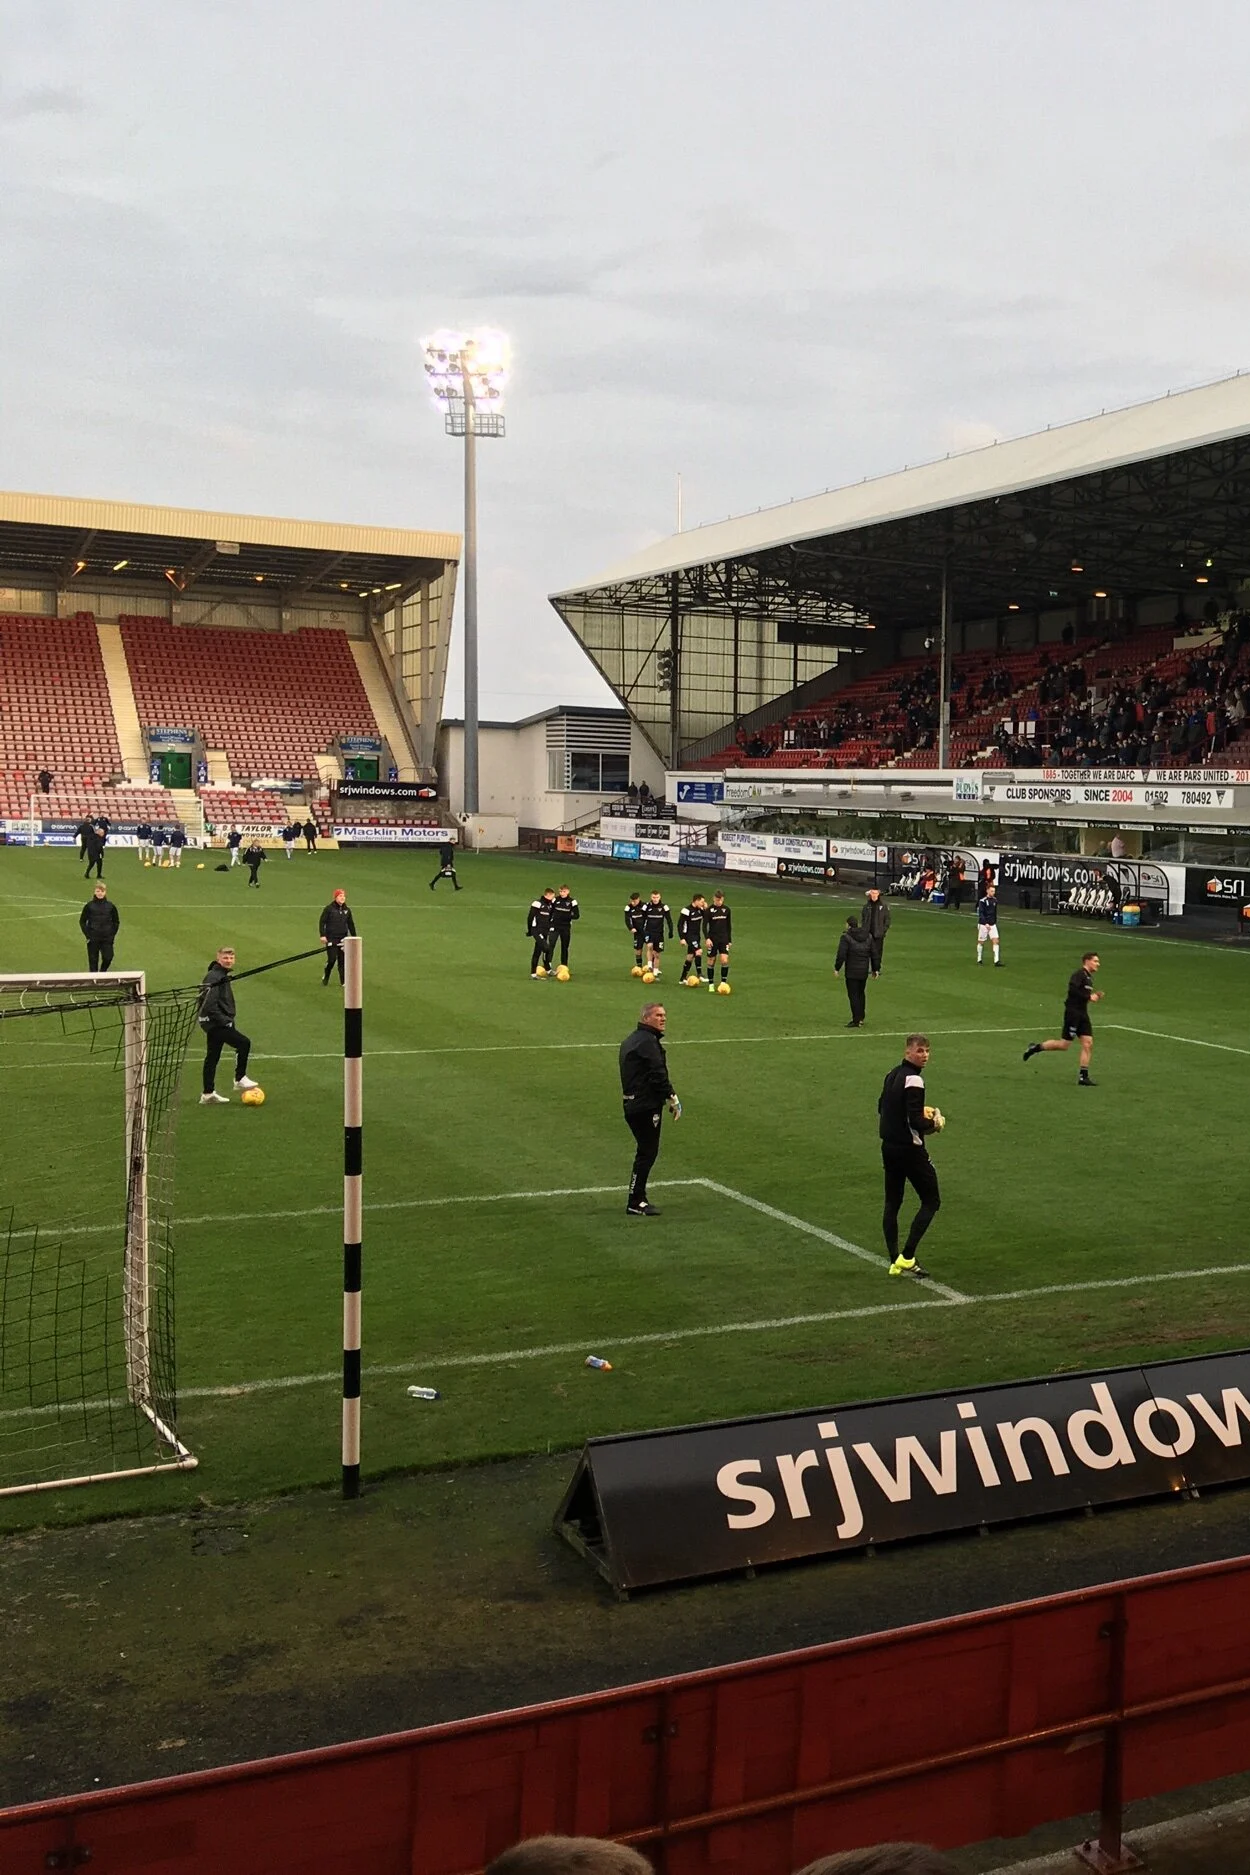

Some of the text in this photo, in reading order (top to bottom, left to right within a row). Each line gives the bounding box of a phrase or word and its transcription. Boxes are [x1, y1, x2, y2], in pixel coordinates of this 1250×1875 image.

[1061, 770, 1090, 781] TOGETHER
[1103, 771, 1116, 781] ARE
[1116, 771, 1135, 781] DAFC
[1156, 771, 1166, 781] WE
[1166, 771, 1182, 782] ARE
[1184, 771, 1202, 782] PARS
[1203, 771, 1229, 782] UNITED
[339, 785, 417, 797] srjwindows.com
[1006, 788, 1071, 801] CLUB SPONSORS
[1084, 789, 1110, 801] SINCE
[1111, 790, 1133, 802] 2004
[1181, 791, 1211, 805] 780492
[344, 827, 449, 838] Macklin Motors
